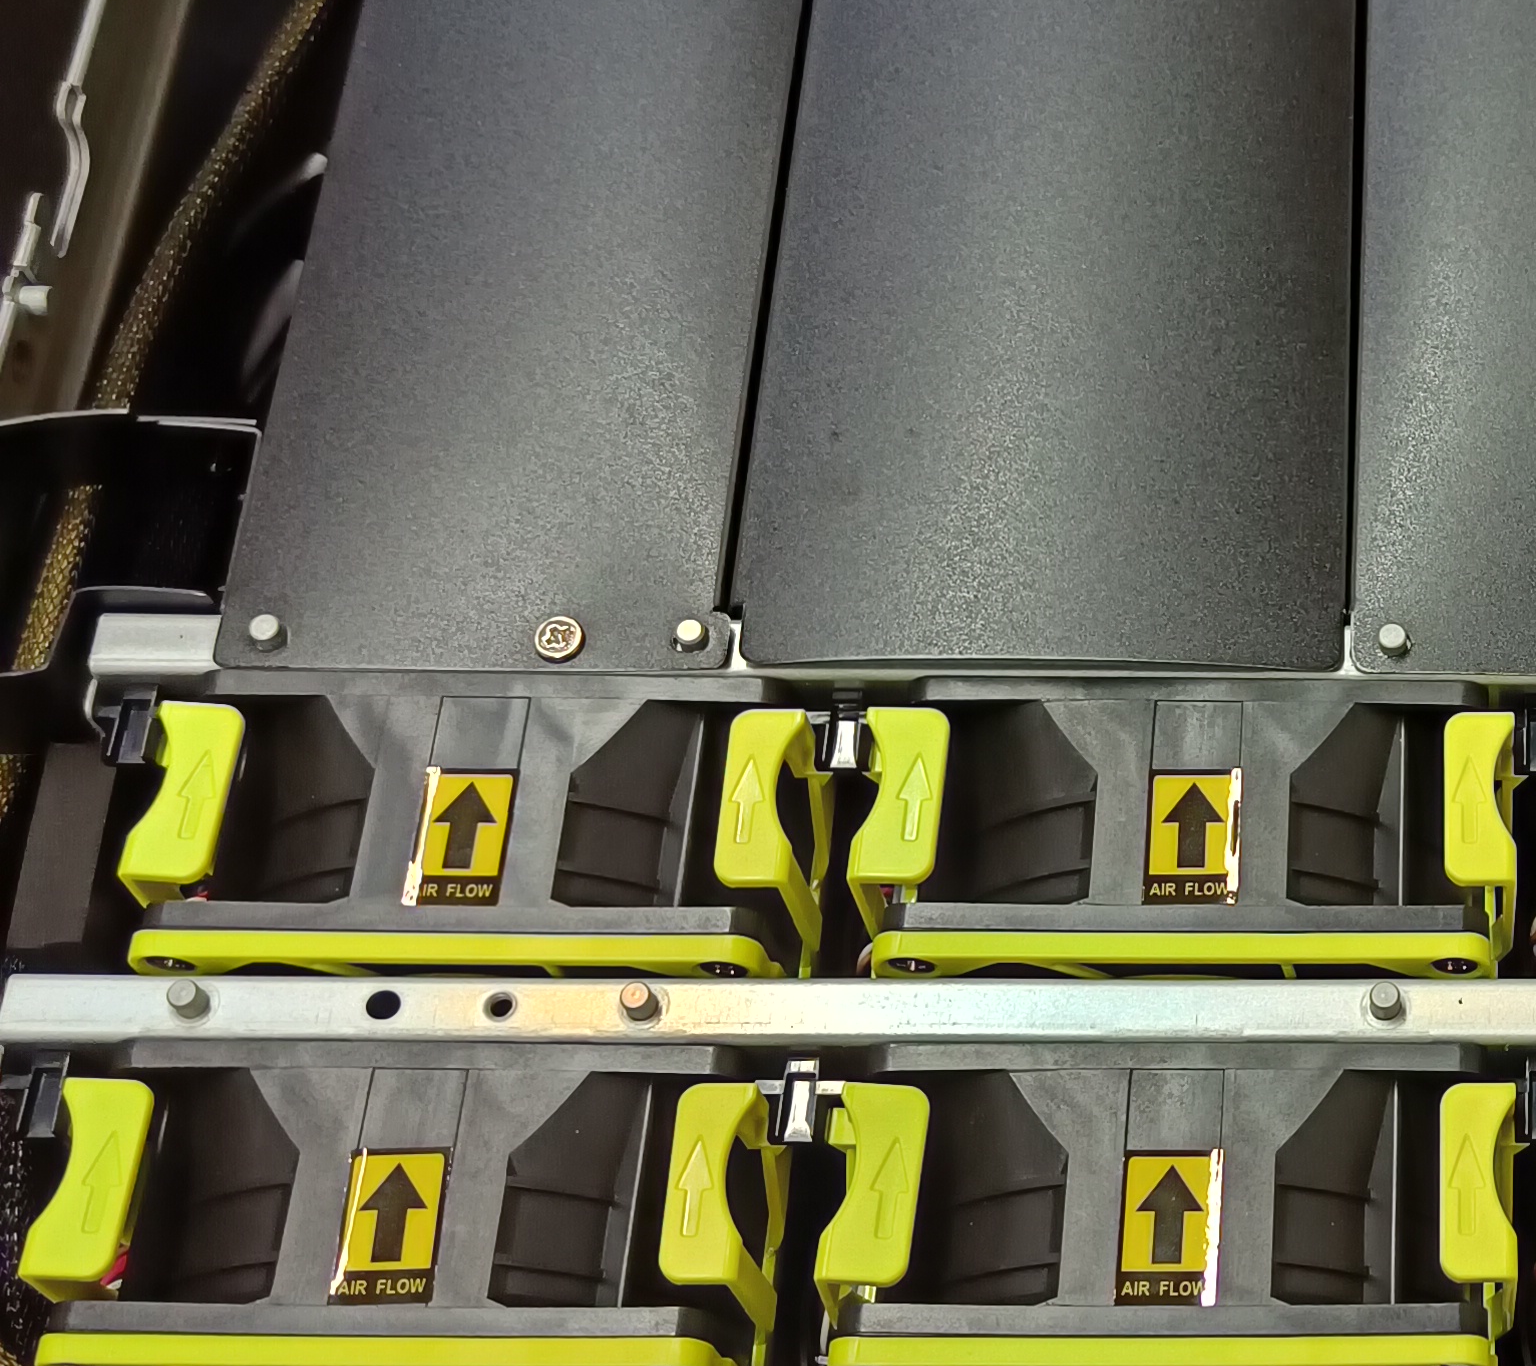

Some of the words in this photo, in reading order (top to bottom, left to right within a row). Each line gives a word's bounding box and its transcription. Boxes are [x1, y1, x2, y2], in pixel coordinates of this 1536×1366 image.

[445, 883, 493, 898] FLOW
[1149, 882, 1176, 896] AIR
[337, 1279, 368, 1296] AIR
[375, 1278, 427, 1295] FLOW
[1120, 1280, 1150, 1297] AIR
